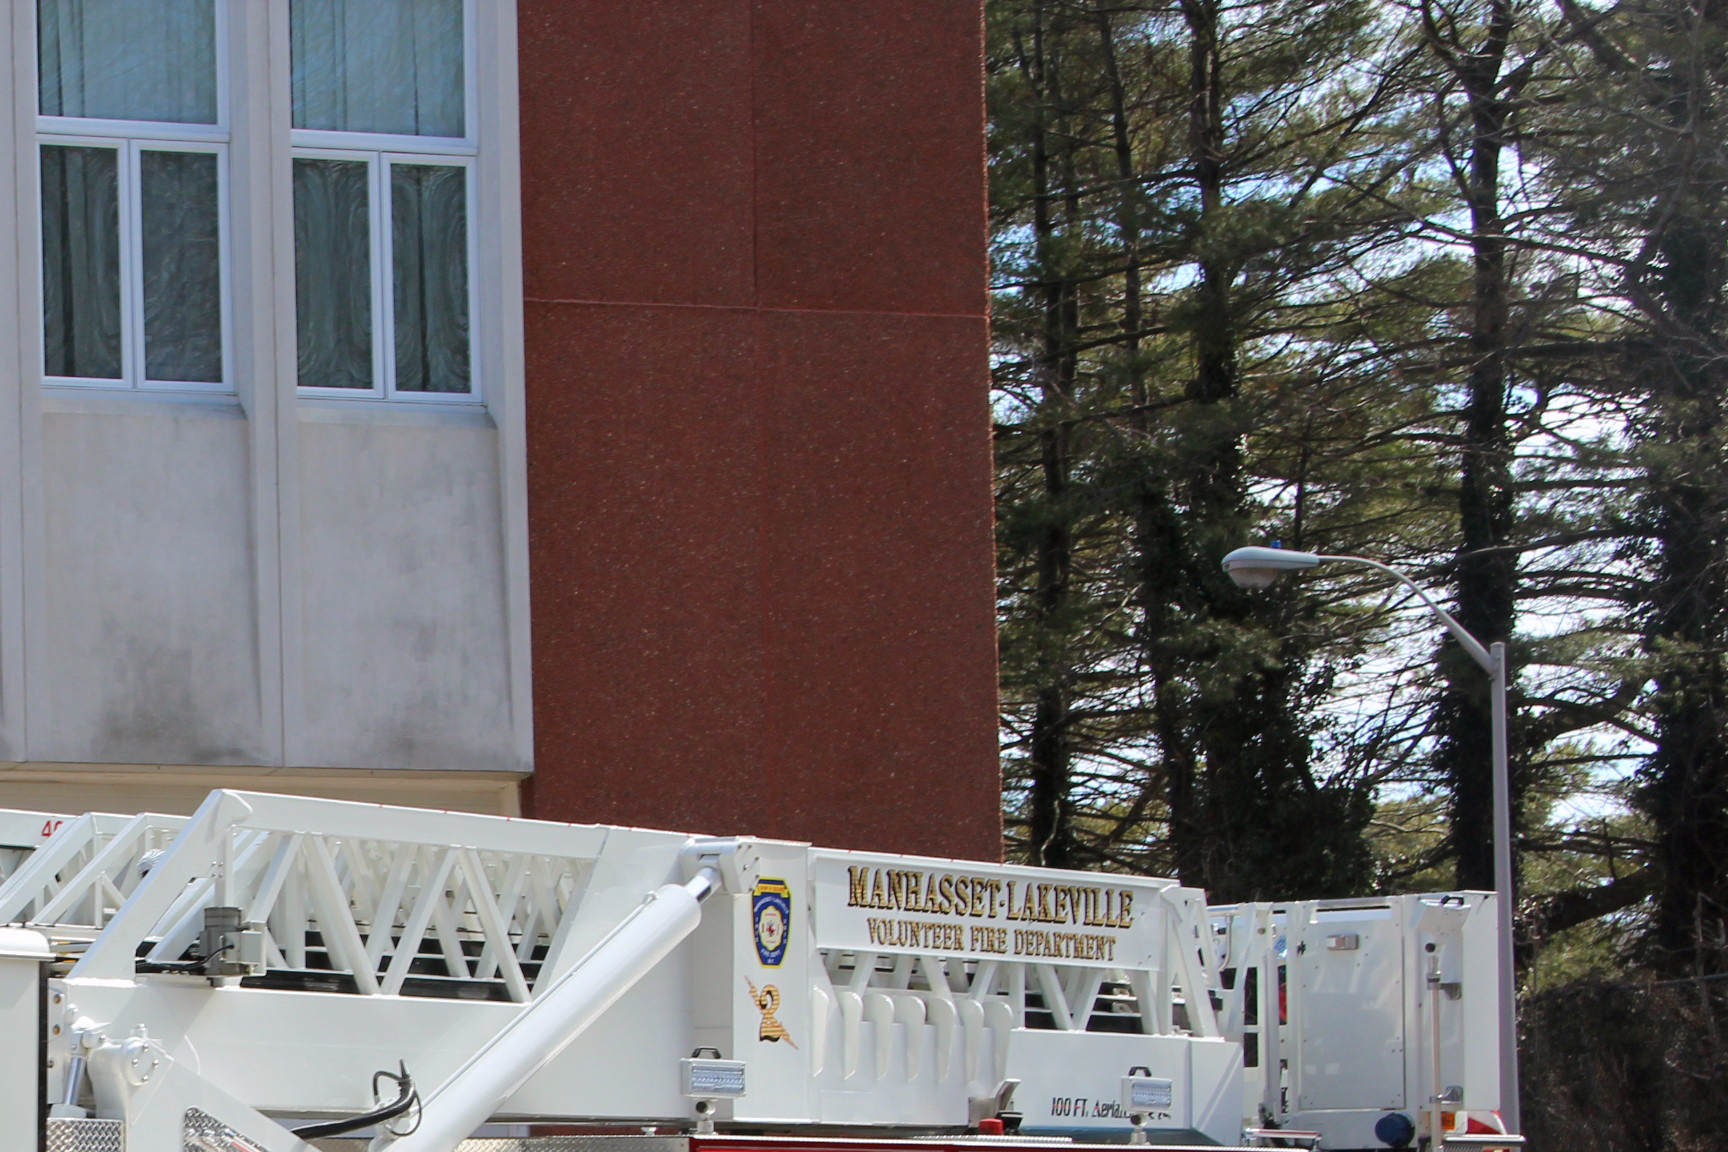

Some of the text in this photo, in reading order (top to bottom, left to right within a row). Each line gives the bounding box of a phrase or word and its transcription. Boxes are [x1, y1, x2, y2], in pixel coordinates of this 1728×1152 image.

[867, 917, 1116, 963] VOLUNTEER FIRE DEPARTMENT
[1051, 1097, 1072, 1116] 100
